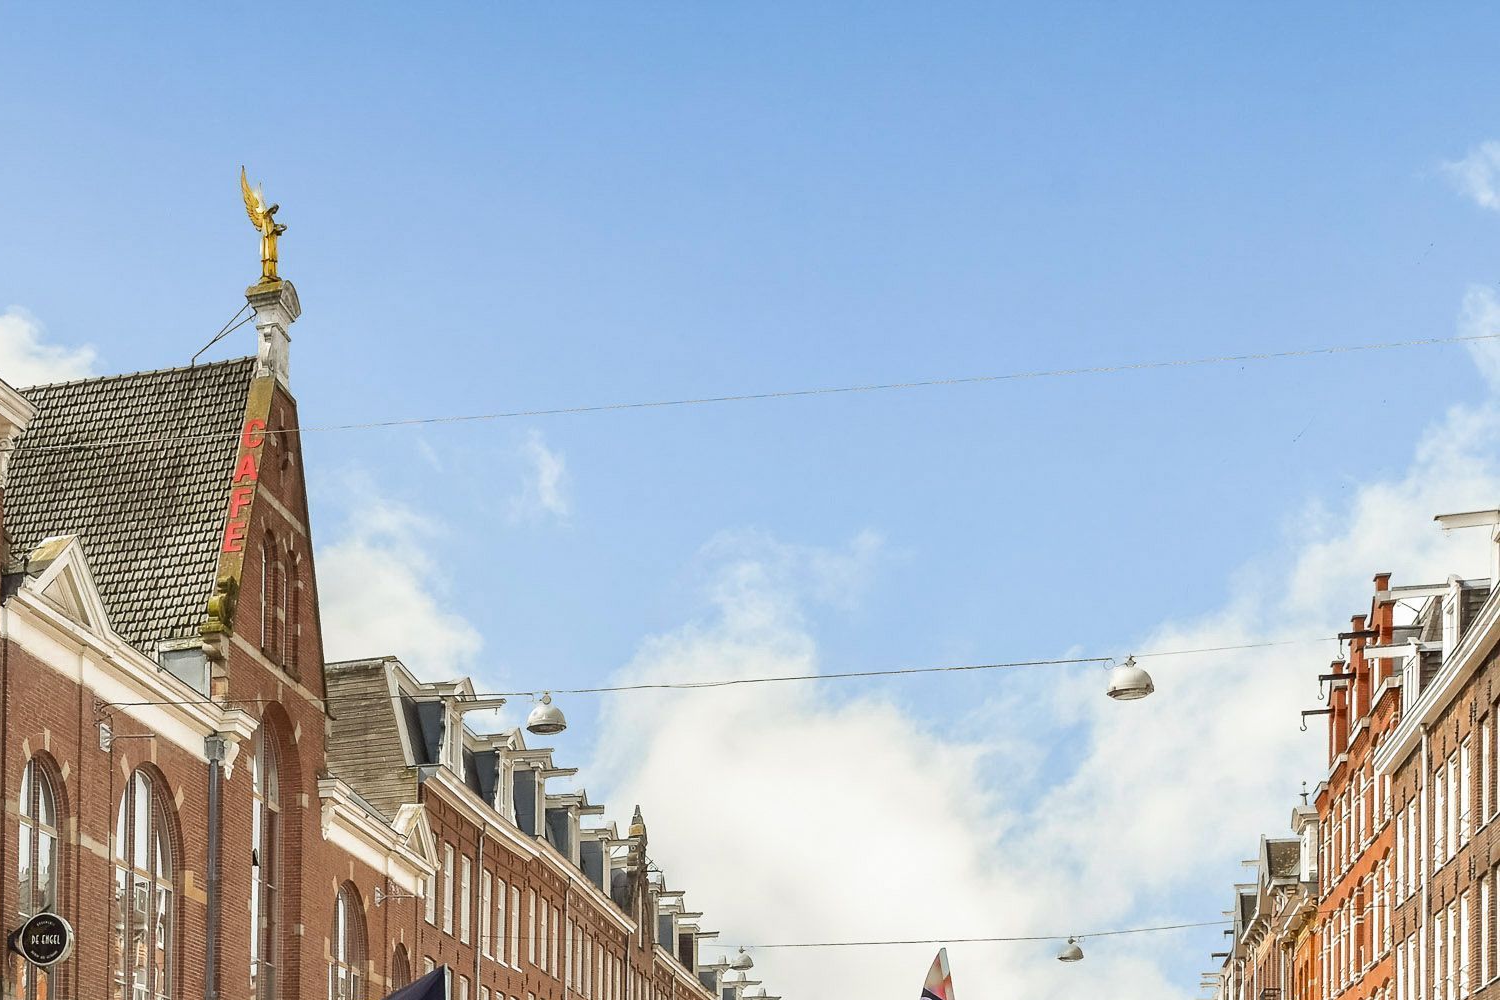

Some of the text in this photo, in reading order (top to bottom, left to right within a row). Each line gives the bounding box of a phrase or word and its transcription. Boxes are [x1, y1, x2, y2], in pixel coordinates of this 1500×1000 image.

[222, 418, 265, 553] CAFE
[31, 934, 61, 945] DE ENGEL
